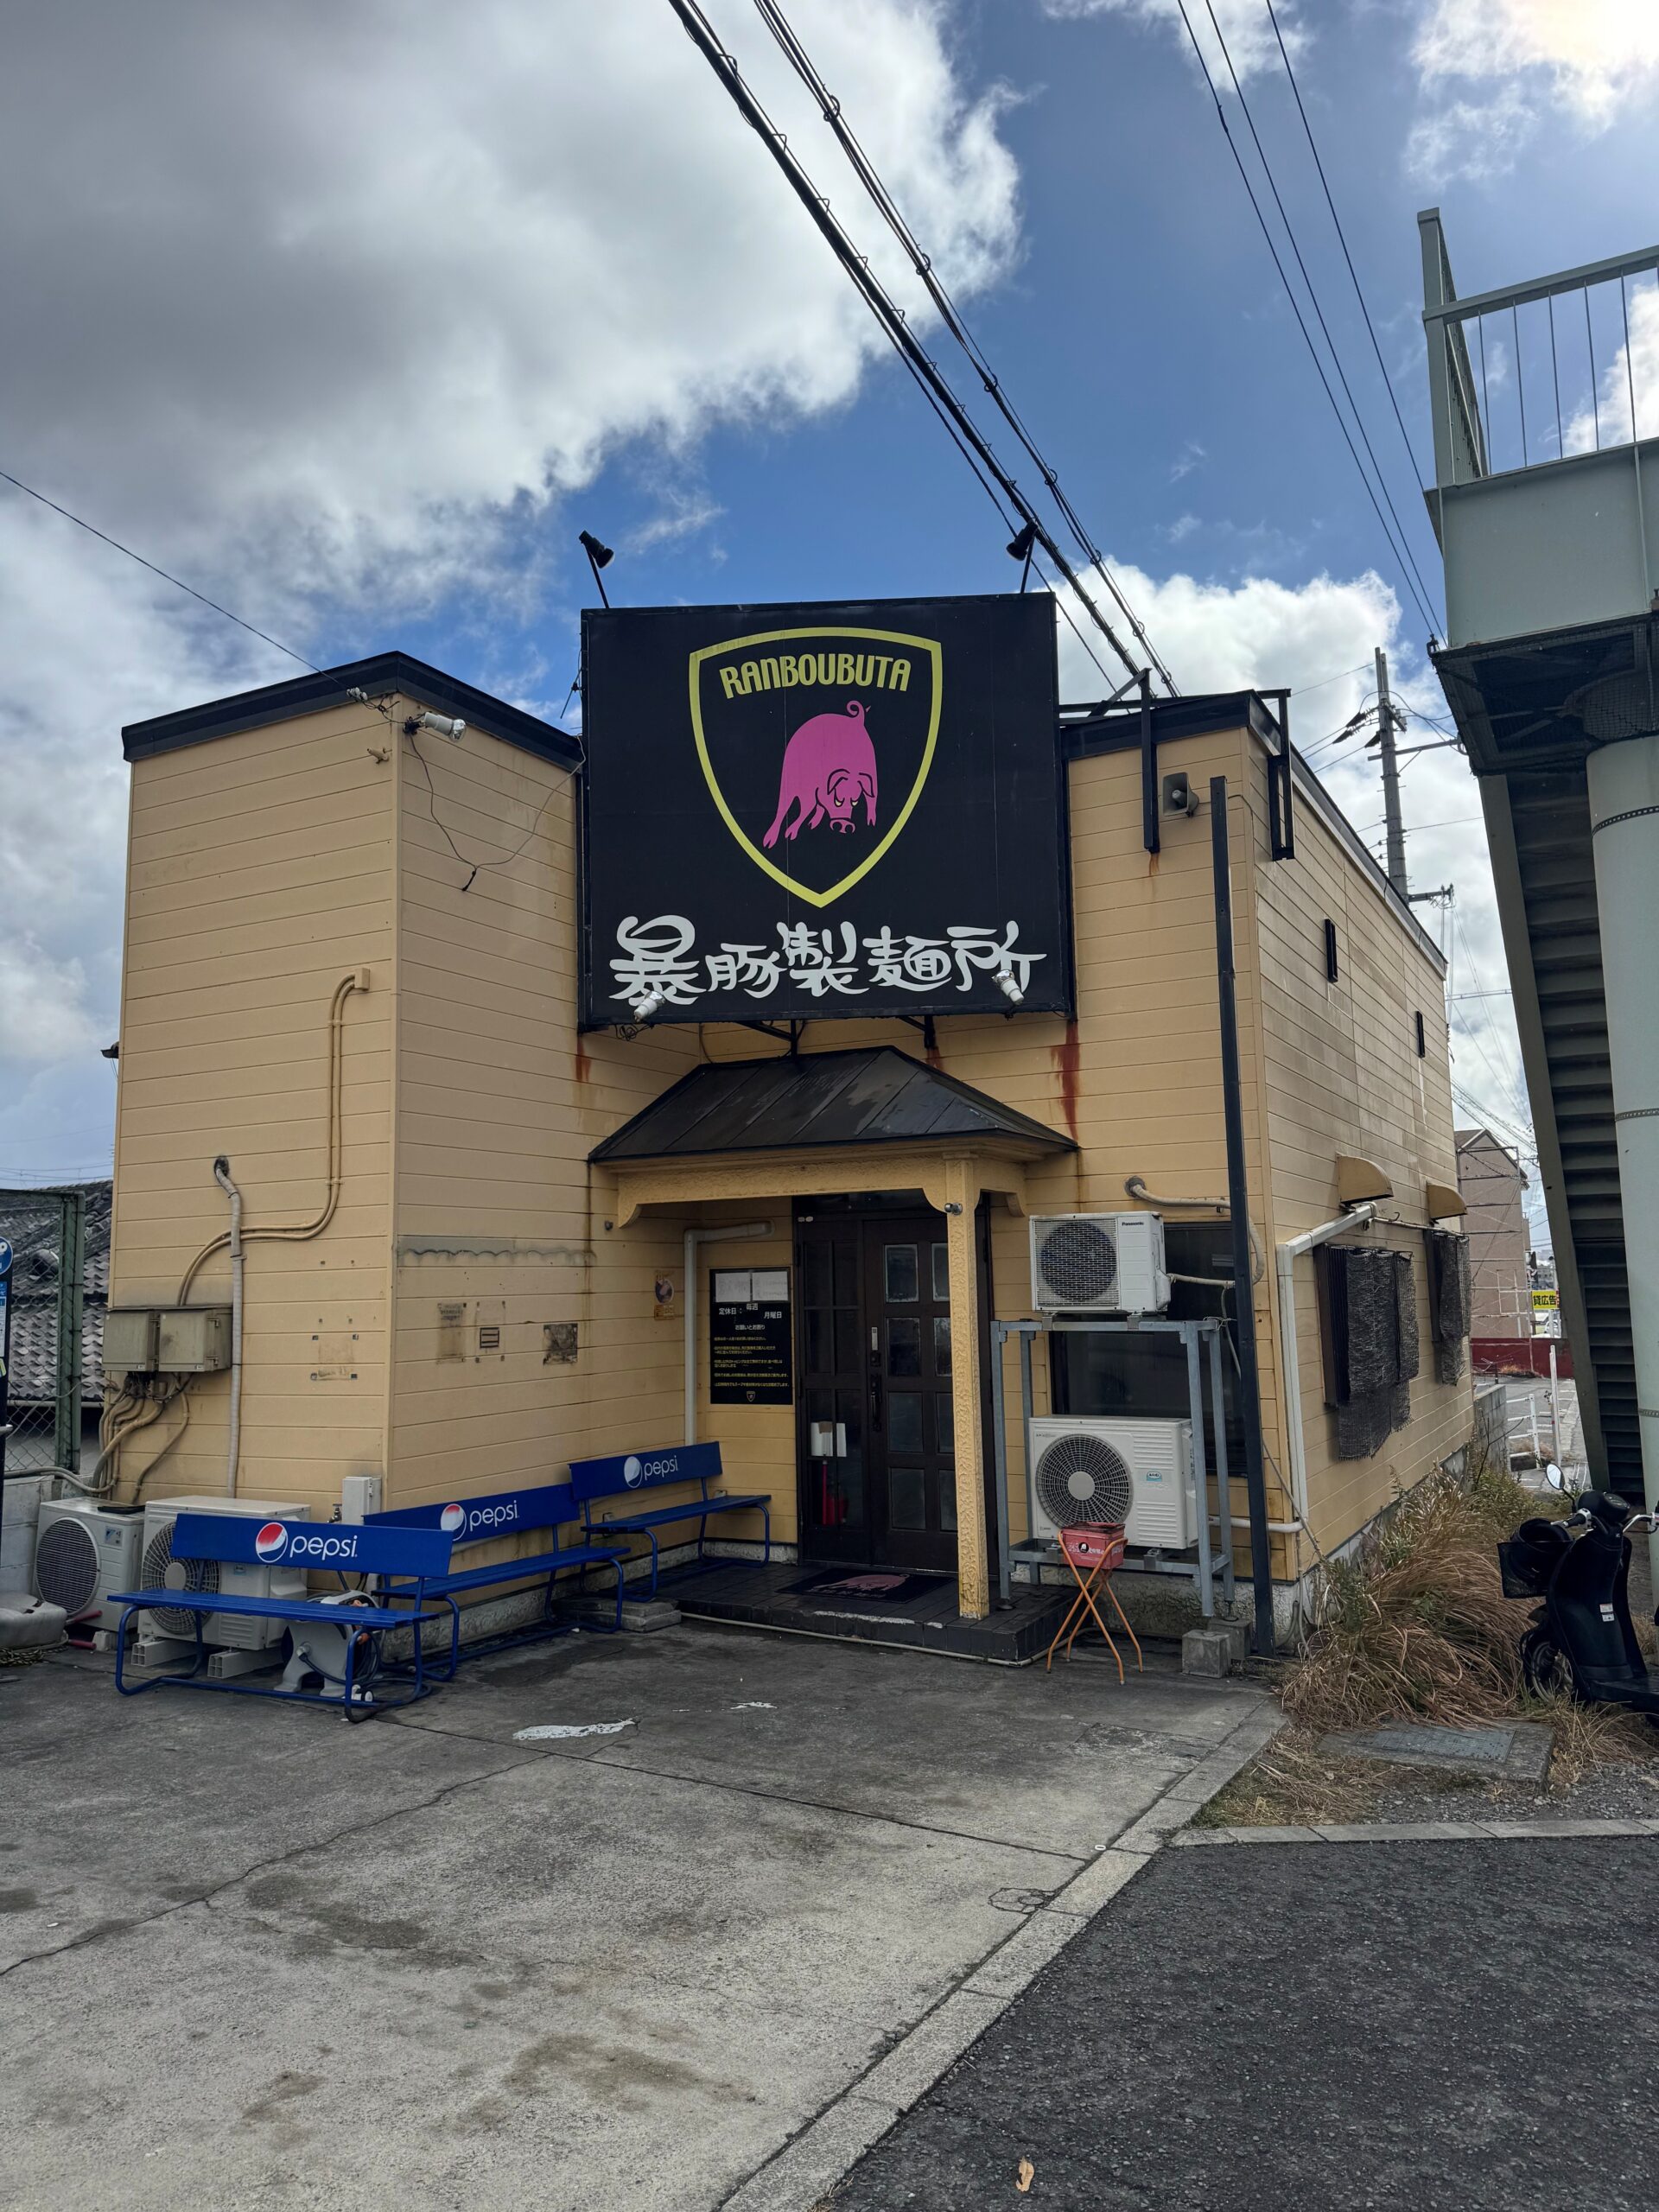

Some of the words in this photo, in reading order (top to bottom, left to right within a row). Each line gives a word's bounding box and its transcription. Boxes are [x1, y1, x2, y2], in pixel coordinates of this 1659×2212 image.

[719, 653, 912, 699] RANBOUBUTA
[609, 914, 1047, 1006] 暴豚製麺所
[644, 1455, 678, 1481] pepsi
[469, 1499, 518, 1532] pepsi
[289, 1535, 358, 1560] pepsi
